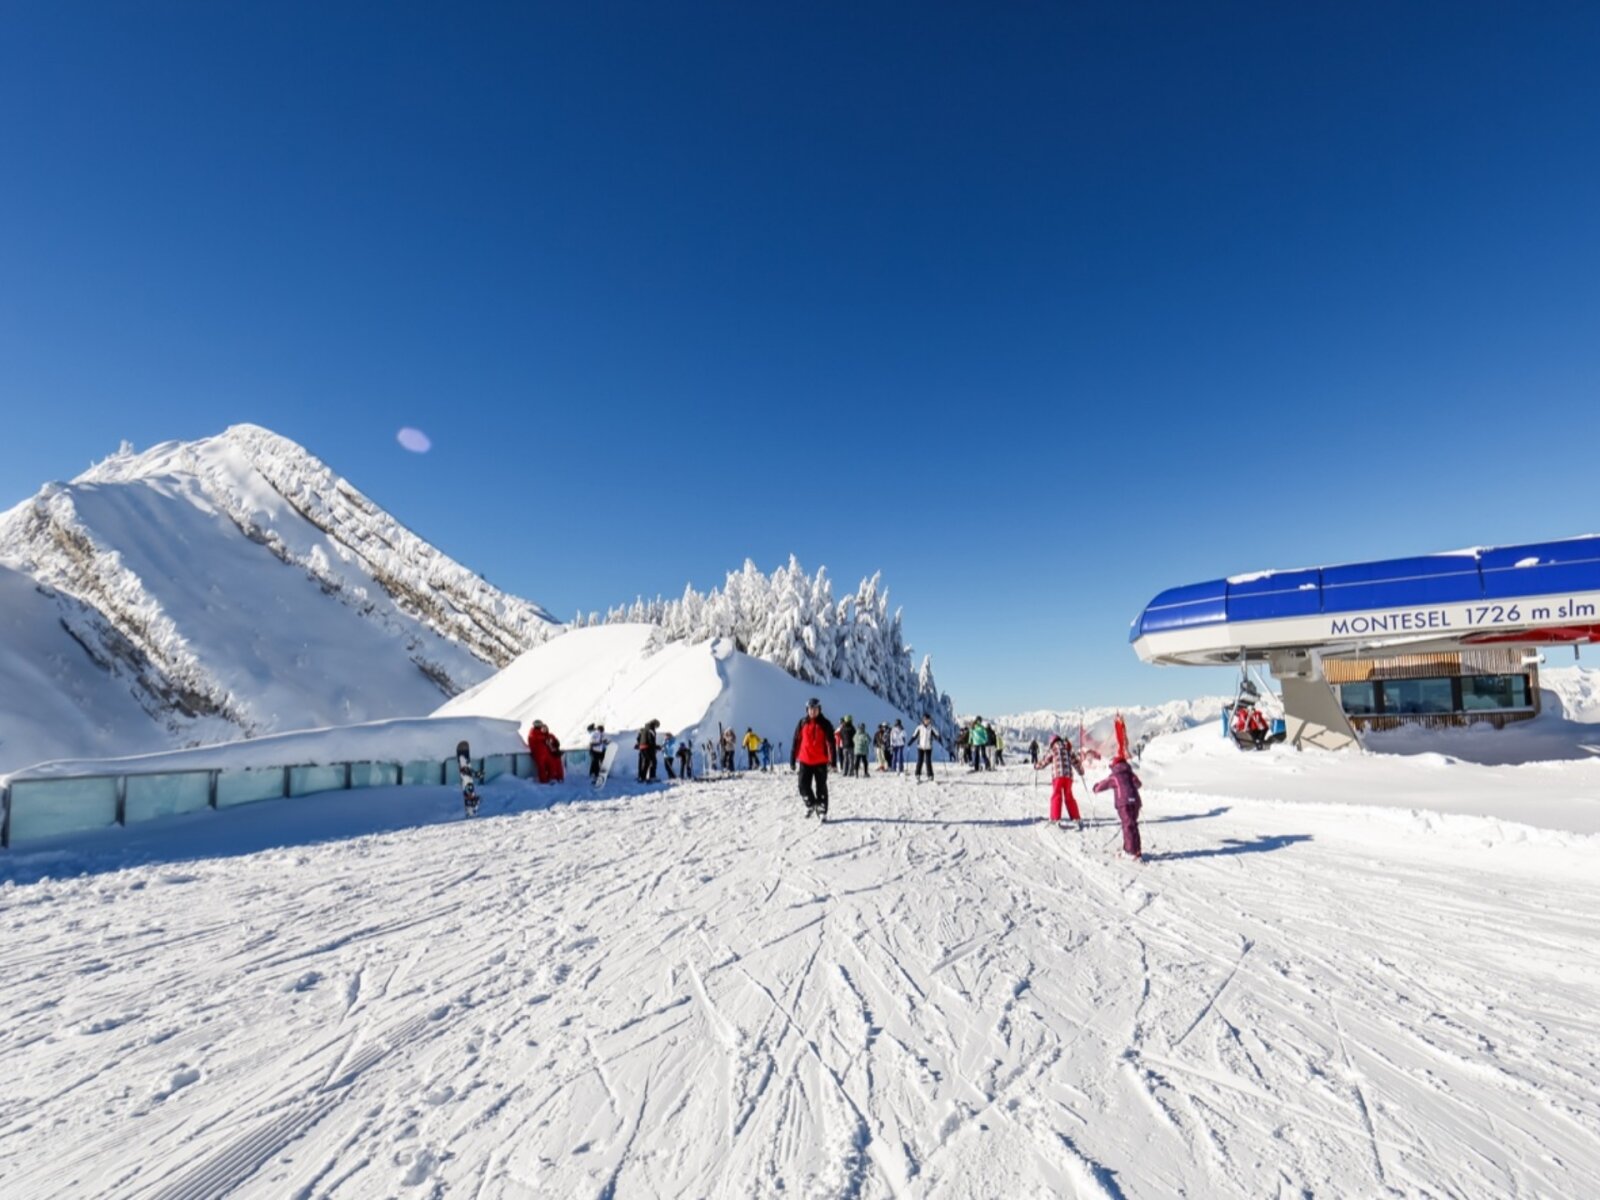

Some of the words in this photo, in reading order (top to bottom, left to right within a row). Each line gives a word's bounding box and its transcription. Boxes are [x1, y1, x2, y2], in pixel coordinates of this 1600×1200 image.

[1331, 611, 1451, 635] MONTESEL
[1465, 604, 1521, 625] 1726
[1531, 607, 1550, 621] m
[1558, 599, 1595, 618] slm
